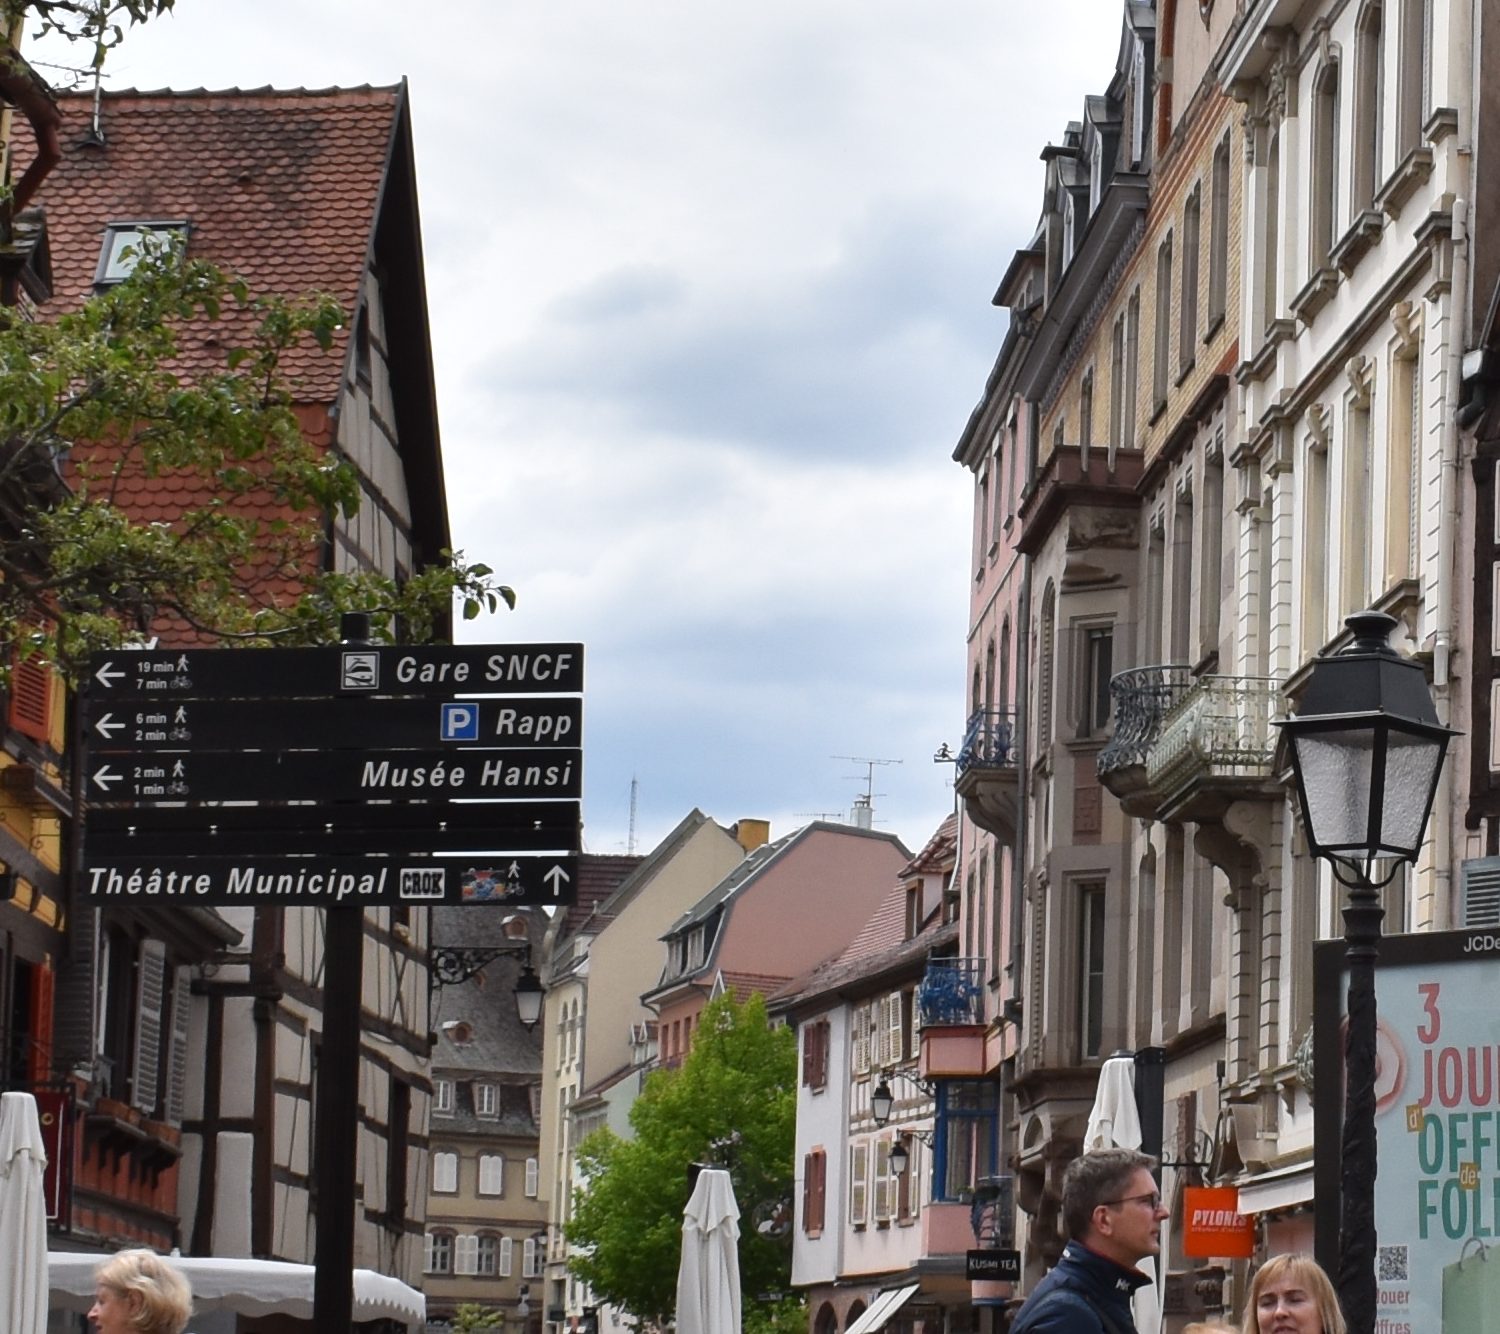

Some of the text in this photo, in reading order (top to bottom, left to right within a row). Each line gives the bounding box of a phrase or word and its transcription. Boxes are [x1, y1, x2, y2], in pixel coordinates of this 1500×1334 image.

[137, 661, 175, 673] 19 min
[397, 654, 573, 683] Gare SNCF
[136, 678, 168, 689] 7 min
[136, 712, 167, 724] 6 min
[447, 708, 572, 742] P Rapp
[135, 729, 167, 741] 2 min
[133, 766, 165, 778] 2 min
[361, 759, 573, 788] Musée Hansi
[134, 783, 165, 795] 1 min
[89, 867, 387, 901] Théâtre Municipal
[401, 870, 444, 897] CROK
[1417, 983, 1440, 1044] 3
[1460, 1165, 1477, 1185] de
[1192, 1209, 1247, 1227] PYLONES
[1001, 1259, 1018, 1271] TEA
